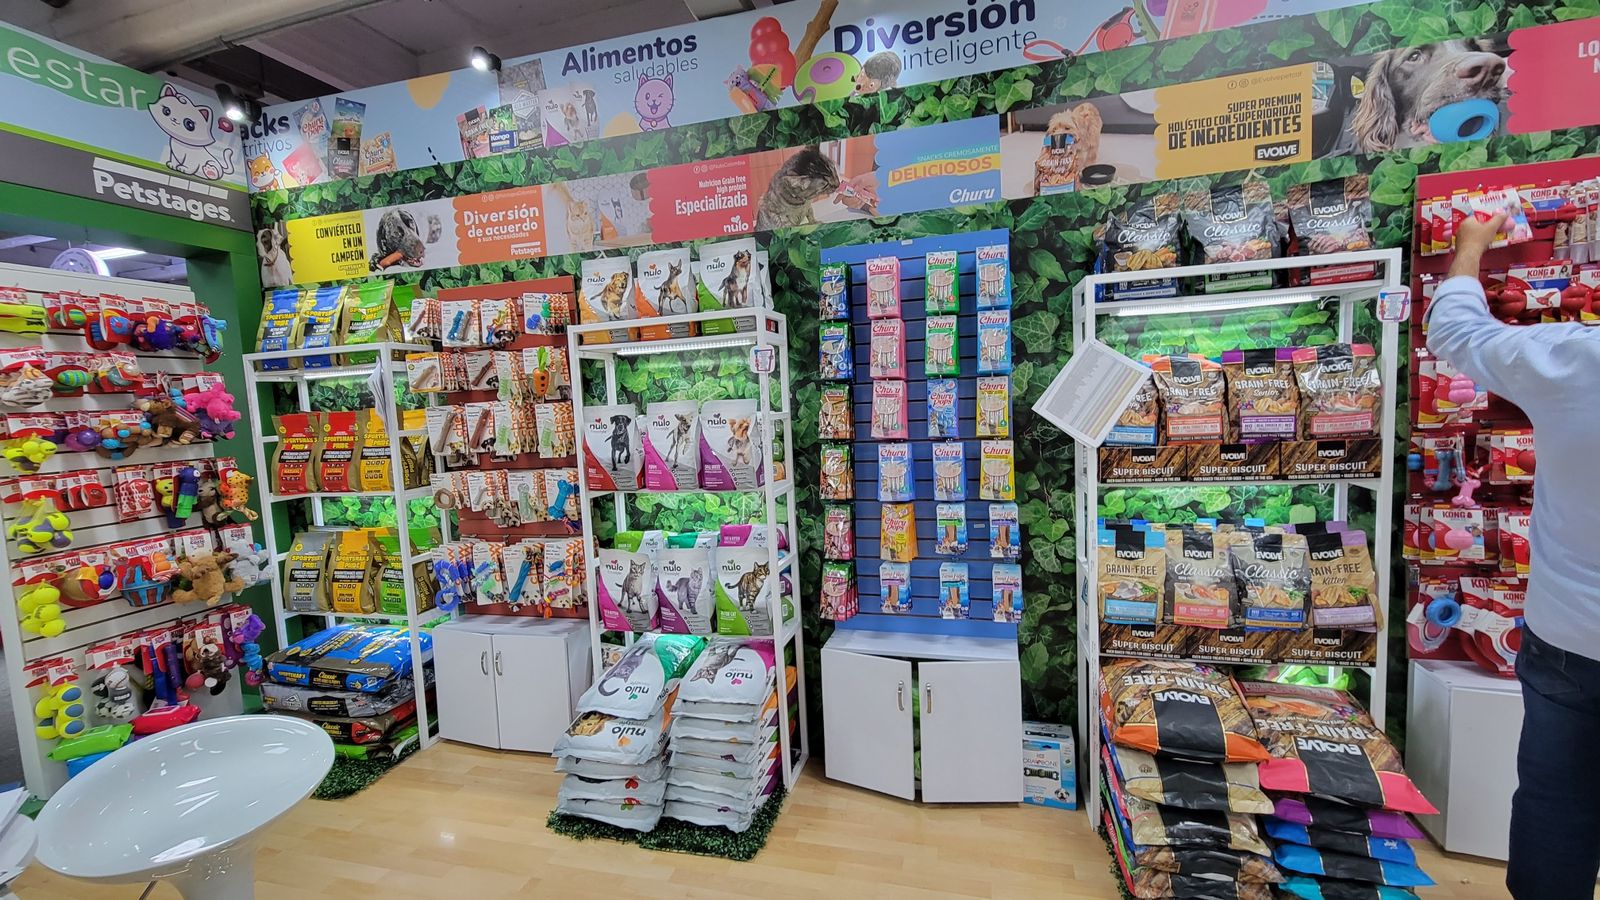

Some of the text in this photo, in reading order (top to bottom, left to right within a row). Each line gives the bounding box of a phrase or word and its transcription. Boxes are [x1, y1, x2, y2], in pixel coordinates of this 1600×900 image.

[834, 0, 1036, 53] Diversión
[561, 34, 697, 77] Alimentos
[903, 29, 1038, 71] inteligente
[614, 57, 698, 84] saludables
[7, 47, 147, 111] estar
[1228, 93, 1302, 113] SUPER PREMIUM
[1168, 103, 1302, 133] HOLÍSTICO CON SUPERIORIDAD
[1168, 115, 1302, 150] DE INGREDIENTES
[917, 145, 999, 162] SNACKS CREMOSAMENTE
[1257, 144, 1297, 159] EVOLVE
[891, 156, 993, 183] DELICIOSOS
[722, 176, 735, 185] Grain
[736, 175, 746, 183] free
[717, 183, 747, 194] high protein
[949, 187, 995, 204] Churu
[1530, 190, 1551, 199] KONG
[675, 191, 748, 216] Especializada
[463, 203, 539, 226] Diversión
[1313, 204, 1345, 215] EVOLVE
[1213, 209, 1245, 222] EVOLVE
[467, 217, 538, 238] de acuerdo
[723, 220, 749, 232] nulo
[1307, 214, 1362, 230] Classic
[315, 222, 361, 239] CONVIÉRTELO
[493, 231, 529, 241] necesidades
[1203, 222, 1262, 239] Classic
[1118, 230, 1171, 243] Classic
[343, 236, 363, 249] EN UN
[331, 249, 364, 263] CAMPEÓN
[978, 250, 1007, 259] Churu
[706, 259, 726, 271] nulo
[927, 256, 955, 265] Churu
[643, 267, 662, 277] nulo
[868, 262, 895, 272] Churu
[1527, 269, 1549, 278] KONG
[587, 275, 606, 284] nulo
[927, 320, 954, 329] Churu
[979, 316, 1008, 325] Churu
[872, 323, 899, 333] Churu
[1246, 367, 1274, 375] EVOLVE
[1173, 375, 1201, 384] EVOLVE
[1235, 379, 1291, 389] GRAIN-FREE
[979, 381, 1007, 391] Churu
[930, 391, 954, 401] Churu
[1253, 388, 1280, 396] Senior
[589, 420, 608, 430] nulo
[652, 417, 671, 427] nulo
[707, 415, 727, 426] nulo
[1516, 437, 1534, 445] KON
[880, 449, 907, 458] Churu
[934, 448, 961, 458] Churu
[983, 446, 1011, 455] Churu
[1113, 466, 1174, 476] SUPER BISCUIT
[1231, 464, 1267, 473] BISCUIT
[1295, 461, 1367, 471] SUPER BISCUIT
[1442, 511, 1465, 519] KONG
[1117, 550, 1144, 558] EVOLVE
[1185, 550, 1213, 558] EVOLVE
[1256, 551, 1282, 560] EVOLVE
[1311, 549, 1343, 560] EVOLVE
[605, 562, 624, 572] nulo
[663, 562, 682, 572] nulo
[722, 561, 742, 572] nulo
[1105, 564, 1158, 575] GRAIN-FREE
[1174, 563, 1225, 577] Classic
[1245, 565, 1299, 579] Classic
[1503, 593, 1525, 601] KONG
[1132, 630, 1154, 638] EVOLVE
[1112, 640, 1174, 651] SUPER BISCUIT
[1199, 645, 1265, 656] SUPER BISCUIT
[1291, 648, 1363, 659] SUPER BISCUIT
[725, 671, 753, 680] nulo
[624, 685, 650, 695] nulo
[1124, 675, 1231, 699] GRAIN-FREE
[1154, 692, 1211, 705] EVOLVE
[612, 726, 647, 738] nulo
[1297, 737, 1363, 755] EVOLVE
